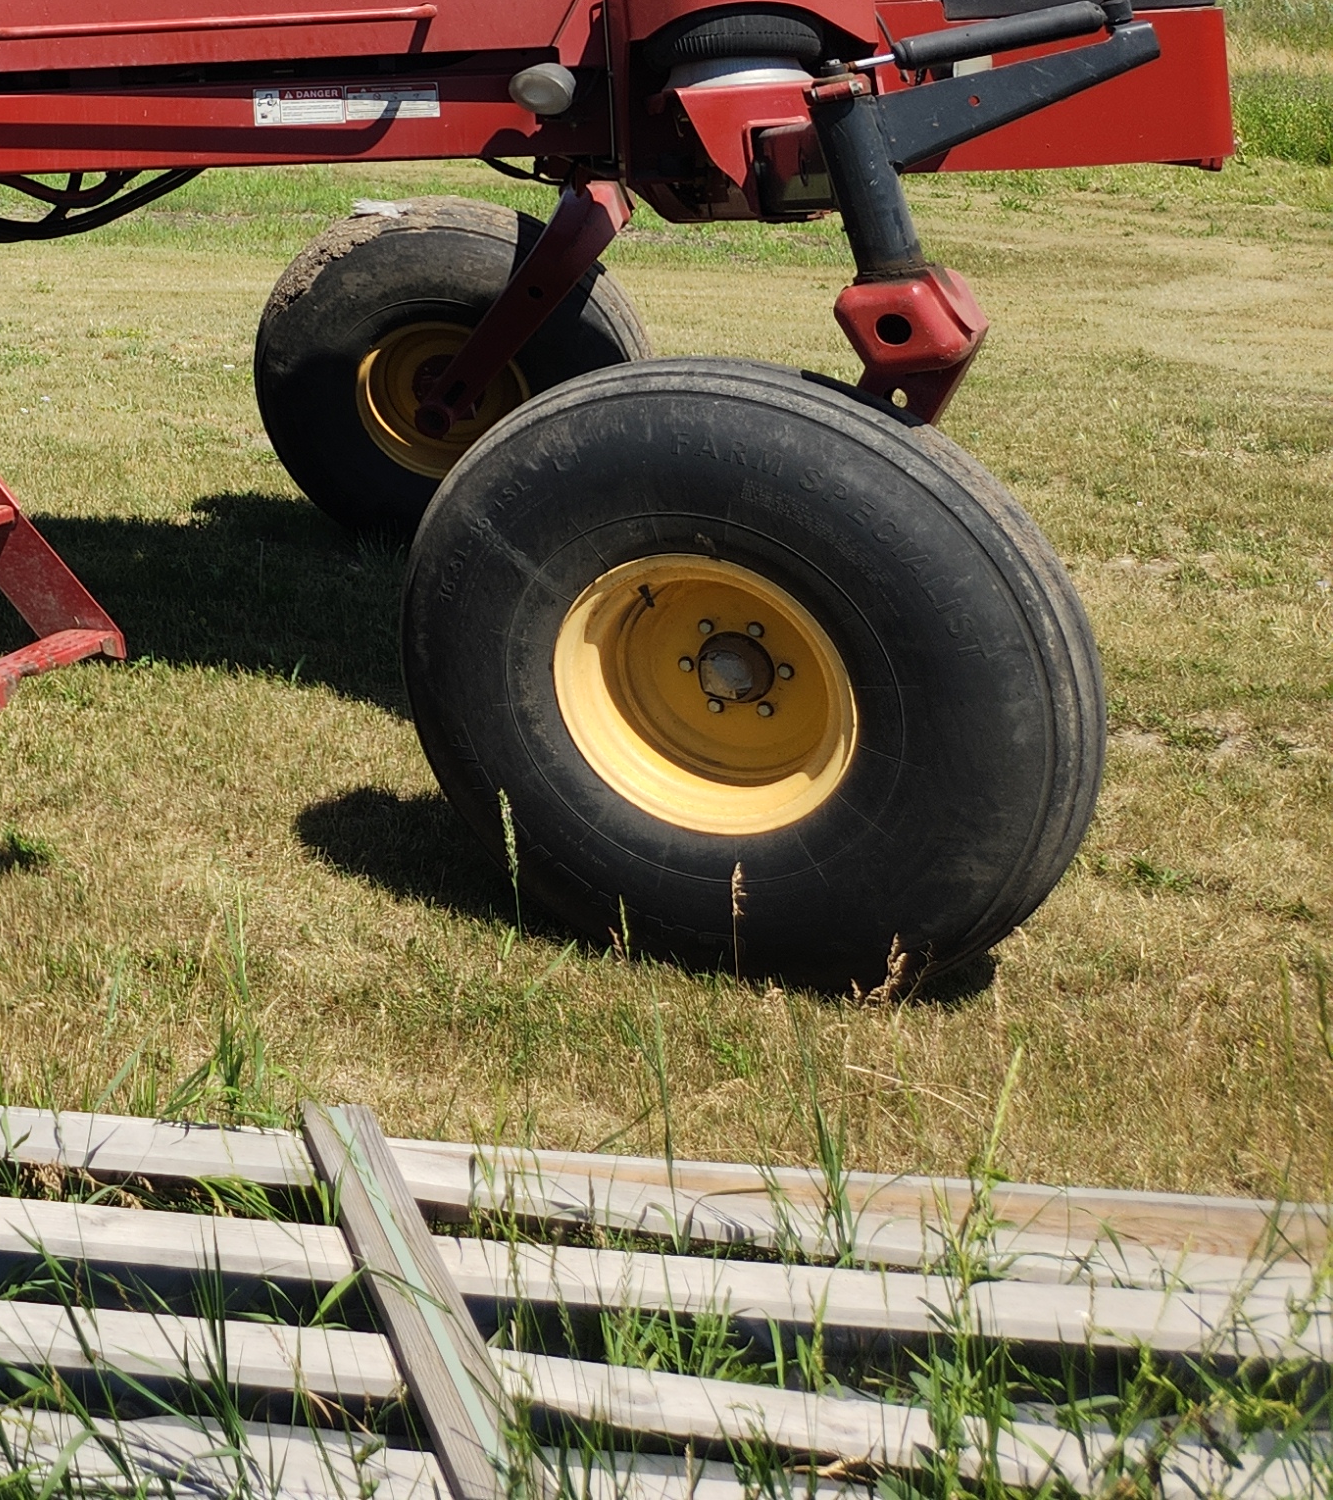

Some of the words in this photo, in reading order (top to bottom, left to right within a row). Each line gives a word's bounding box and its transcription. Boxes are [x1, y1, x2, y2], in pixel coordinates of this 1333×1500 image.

[295, 89, 339, 99] DANGER
[669, 432, 783, 478] FARM
[798, 466, 995, 662] SPECIALIST
